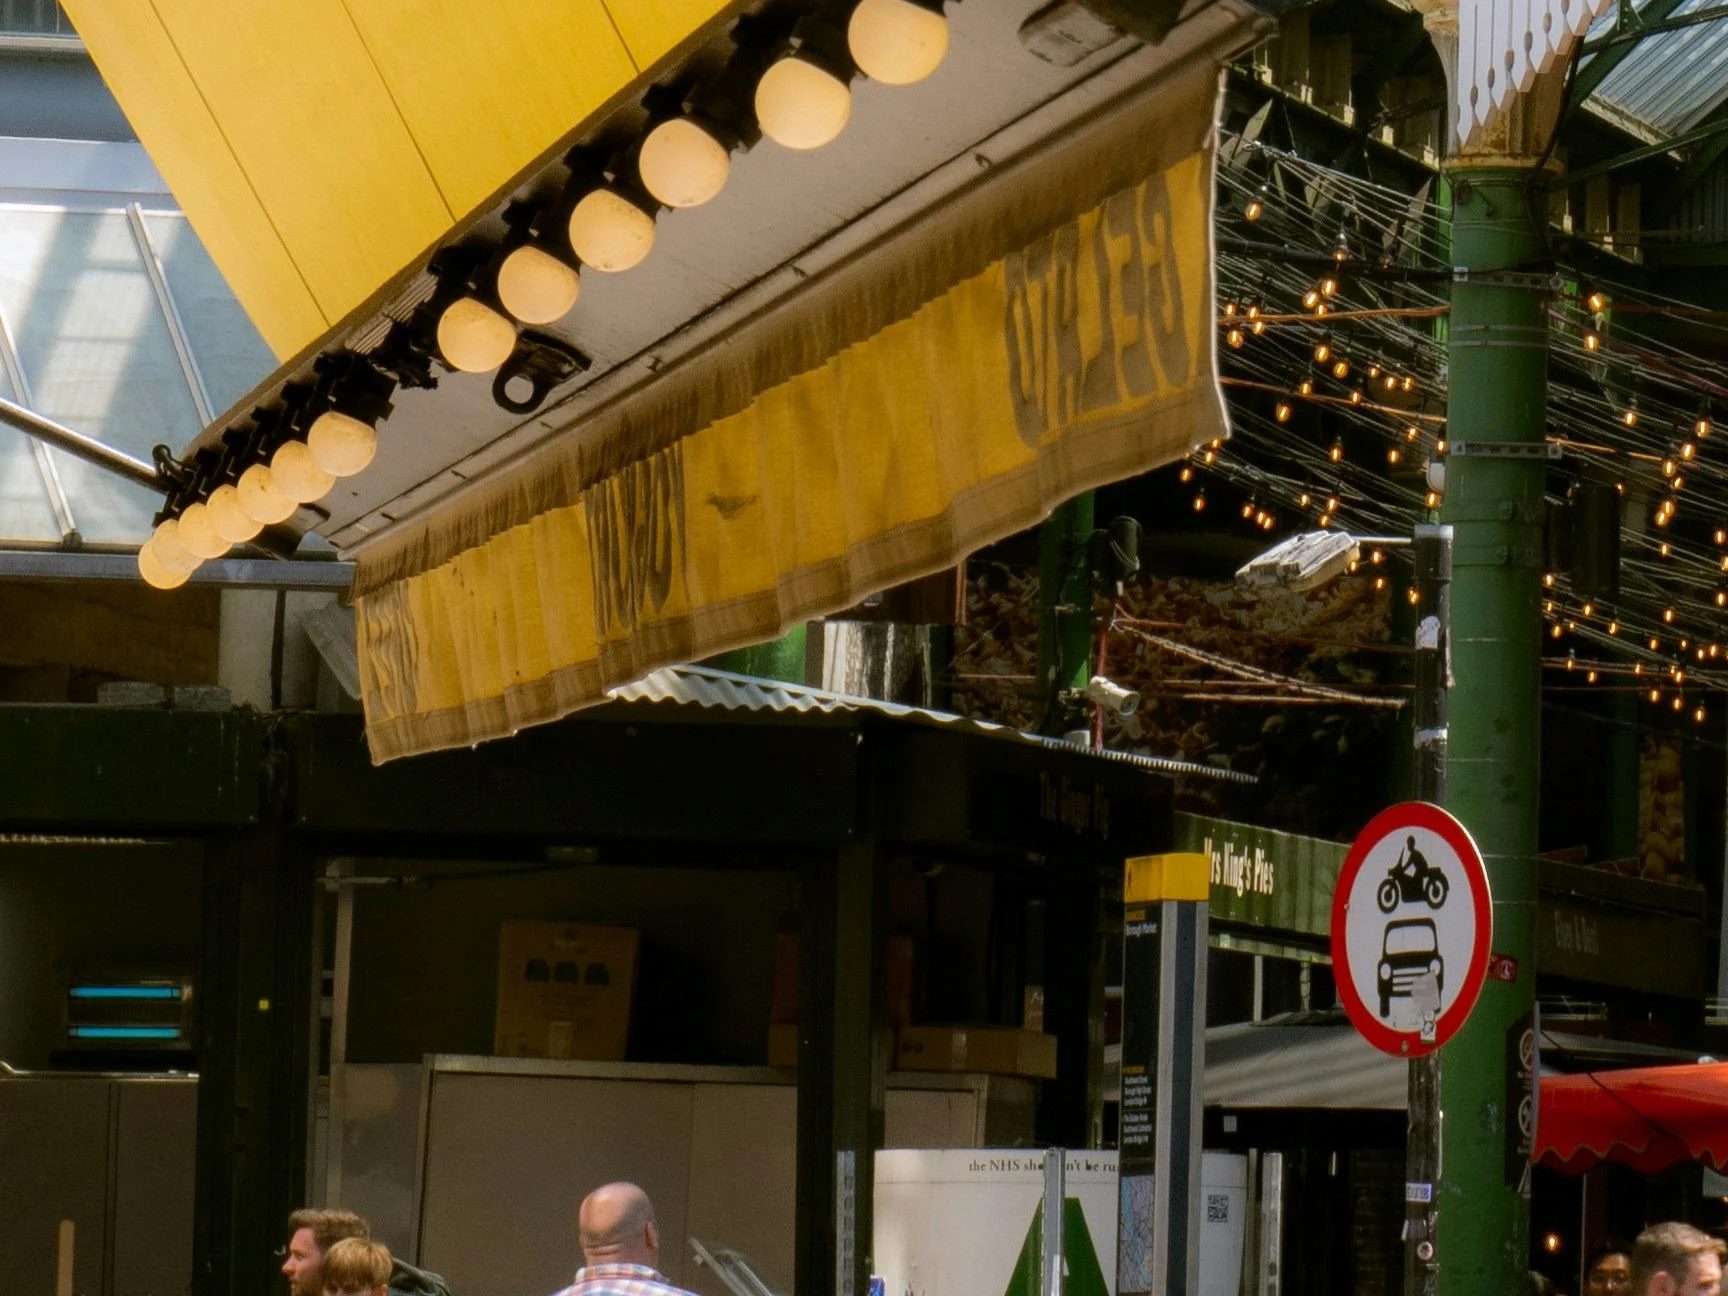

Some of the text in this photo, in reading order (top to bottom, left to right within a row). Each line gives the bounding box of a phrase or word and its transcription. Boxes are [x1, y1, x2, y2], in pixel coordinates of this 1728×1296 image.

[1223, 840, 1252, 898] King's
[1254, 847, 1274, 896] Pies
[969, 1159, 987, 1172] the
[989, 1159, 1020, 1171] NHS
[1085, 1159, 1099, 1172] be
[1103, 1162, 1119, 1172] ru
